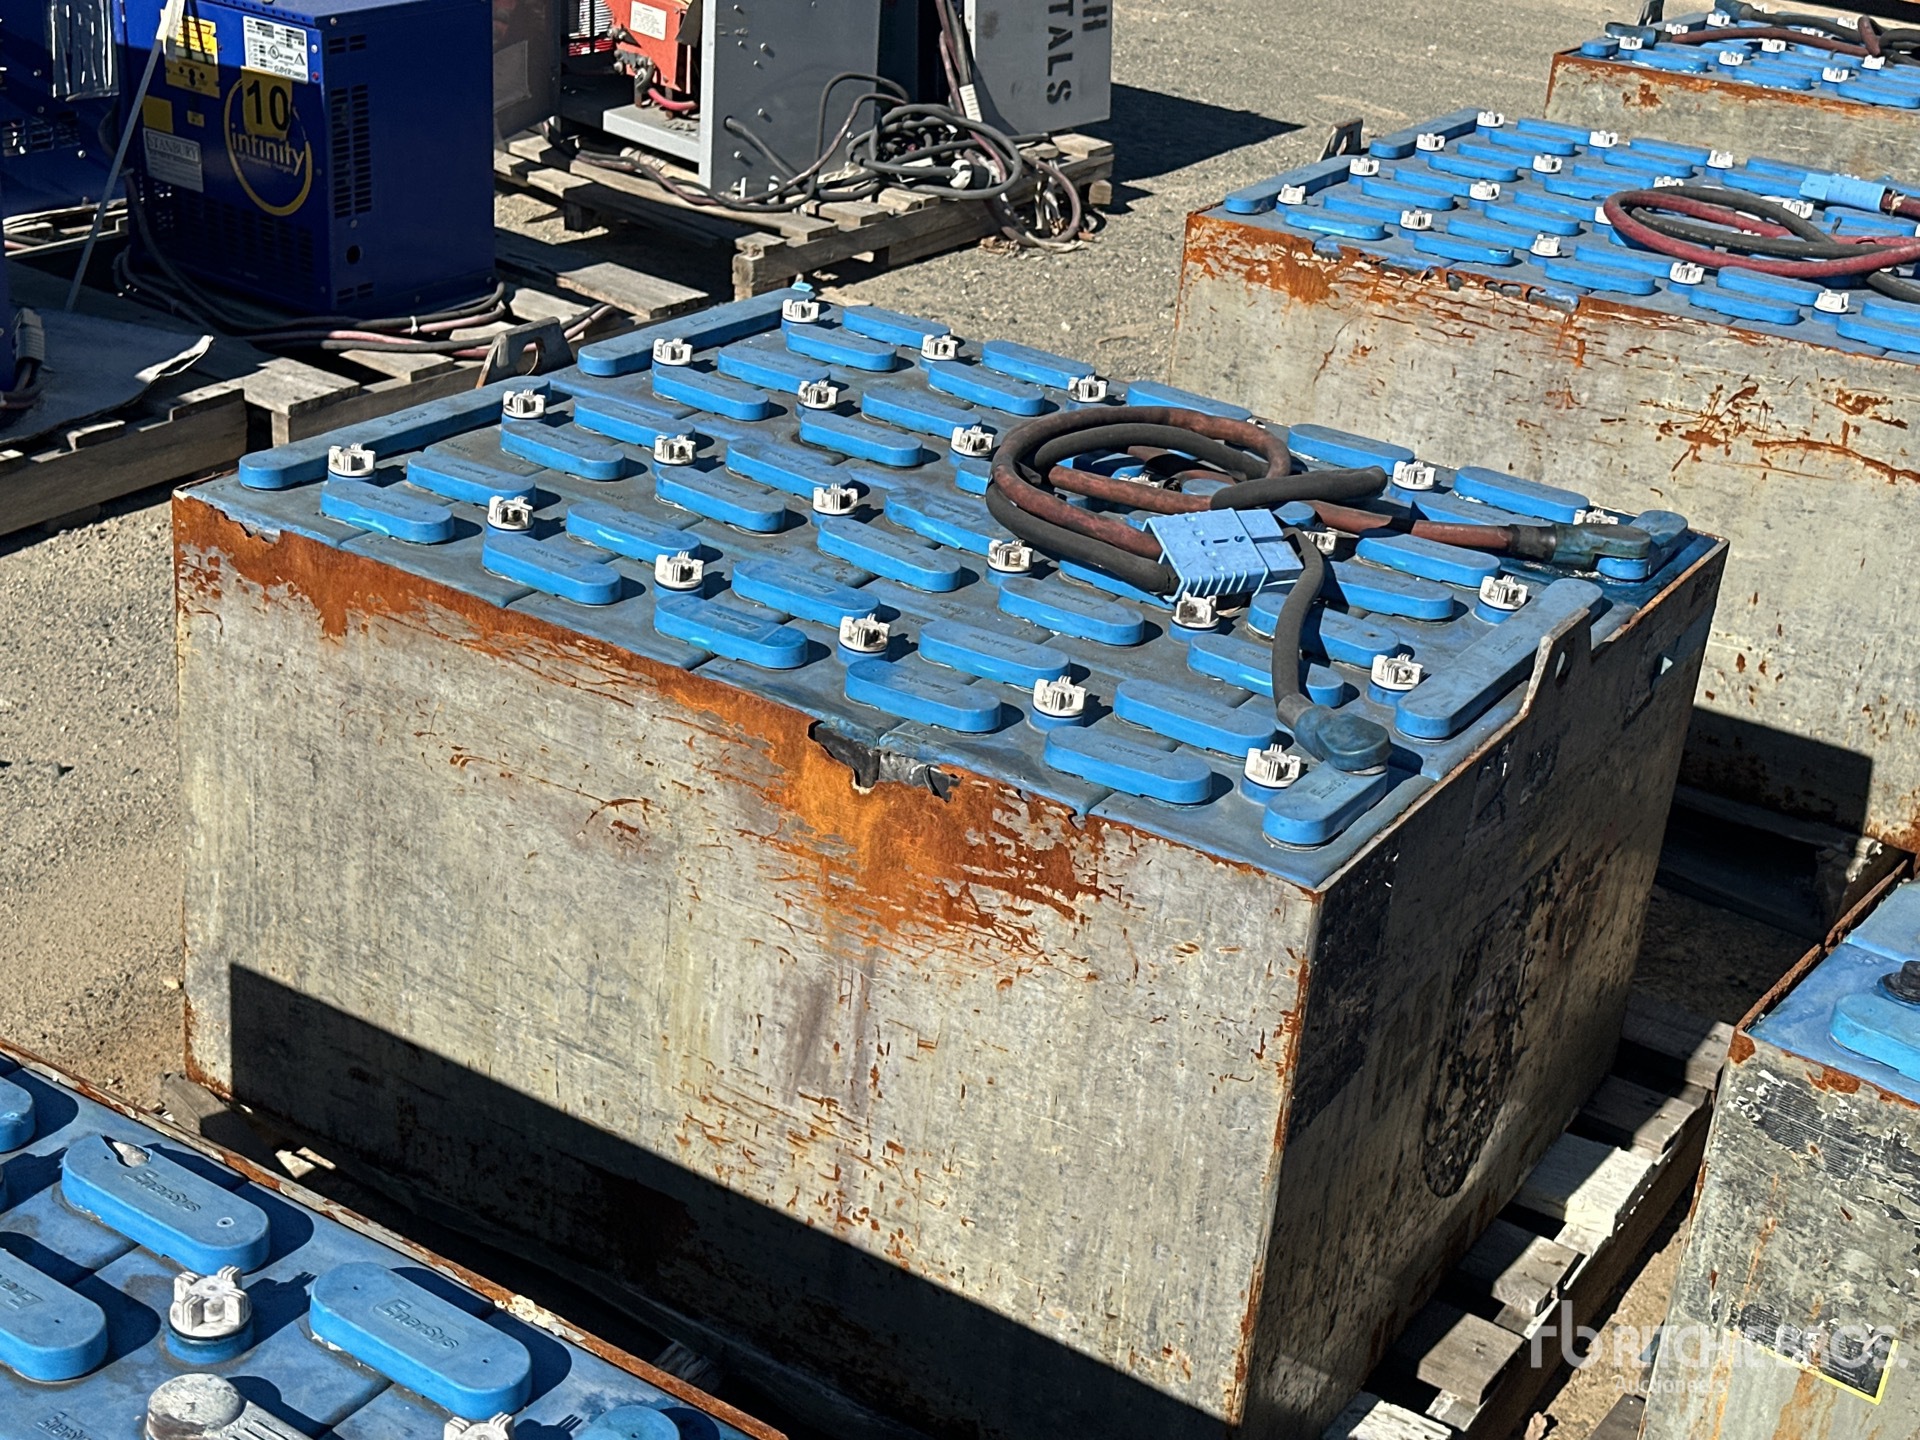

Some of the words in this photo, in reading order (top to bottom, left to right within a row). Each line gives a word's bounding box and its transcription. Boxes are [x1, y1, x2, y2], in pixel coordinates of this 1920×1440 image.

[246, 79, 290, 132] 10
[230, 122, 305, 176] infinity
[122, 1168, 201, 1212] EnerSys
[373, 1299, 459, 1349] EnerSys
